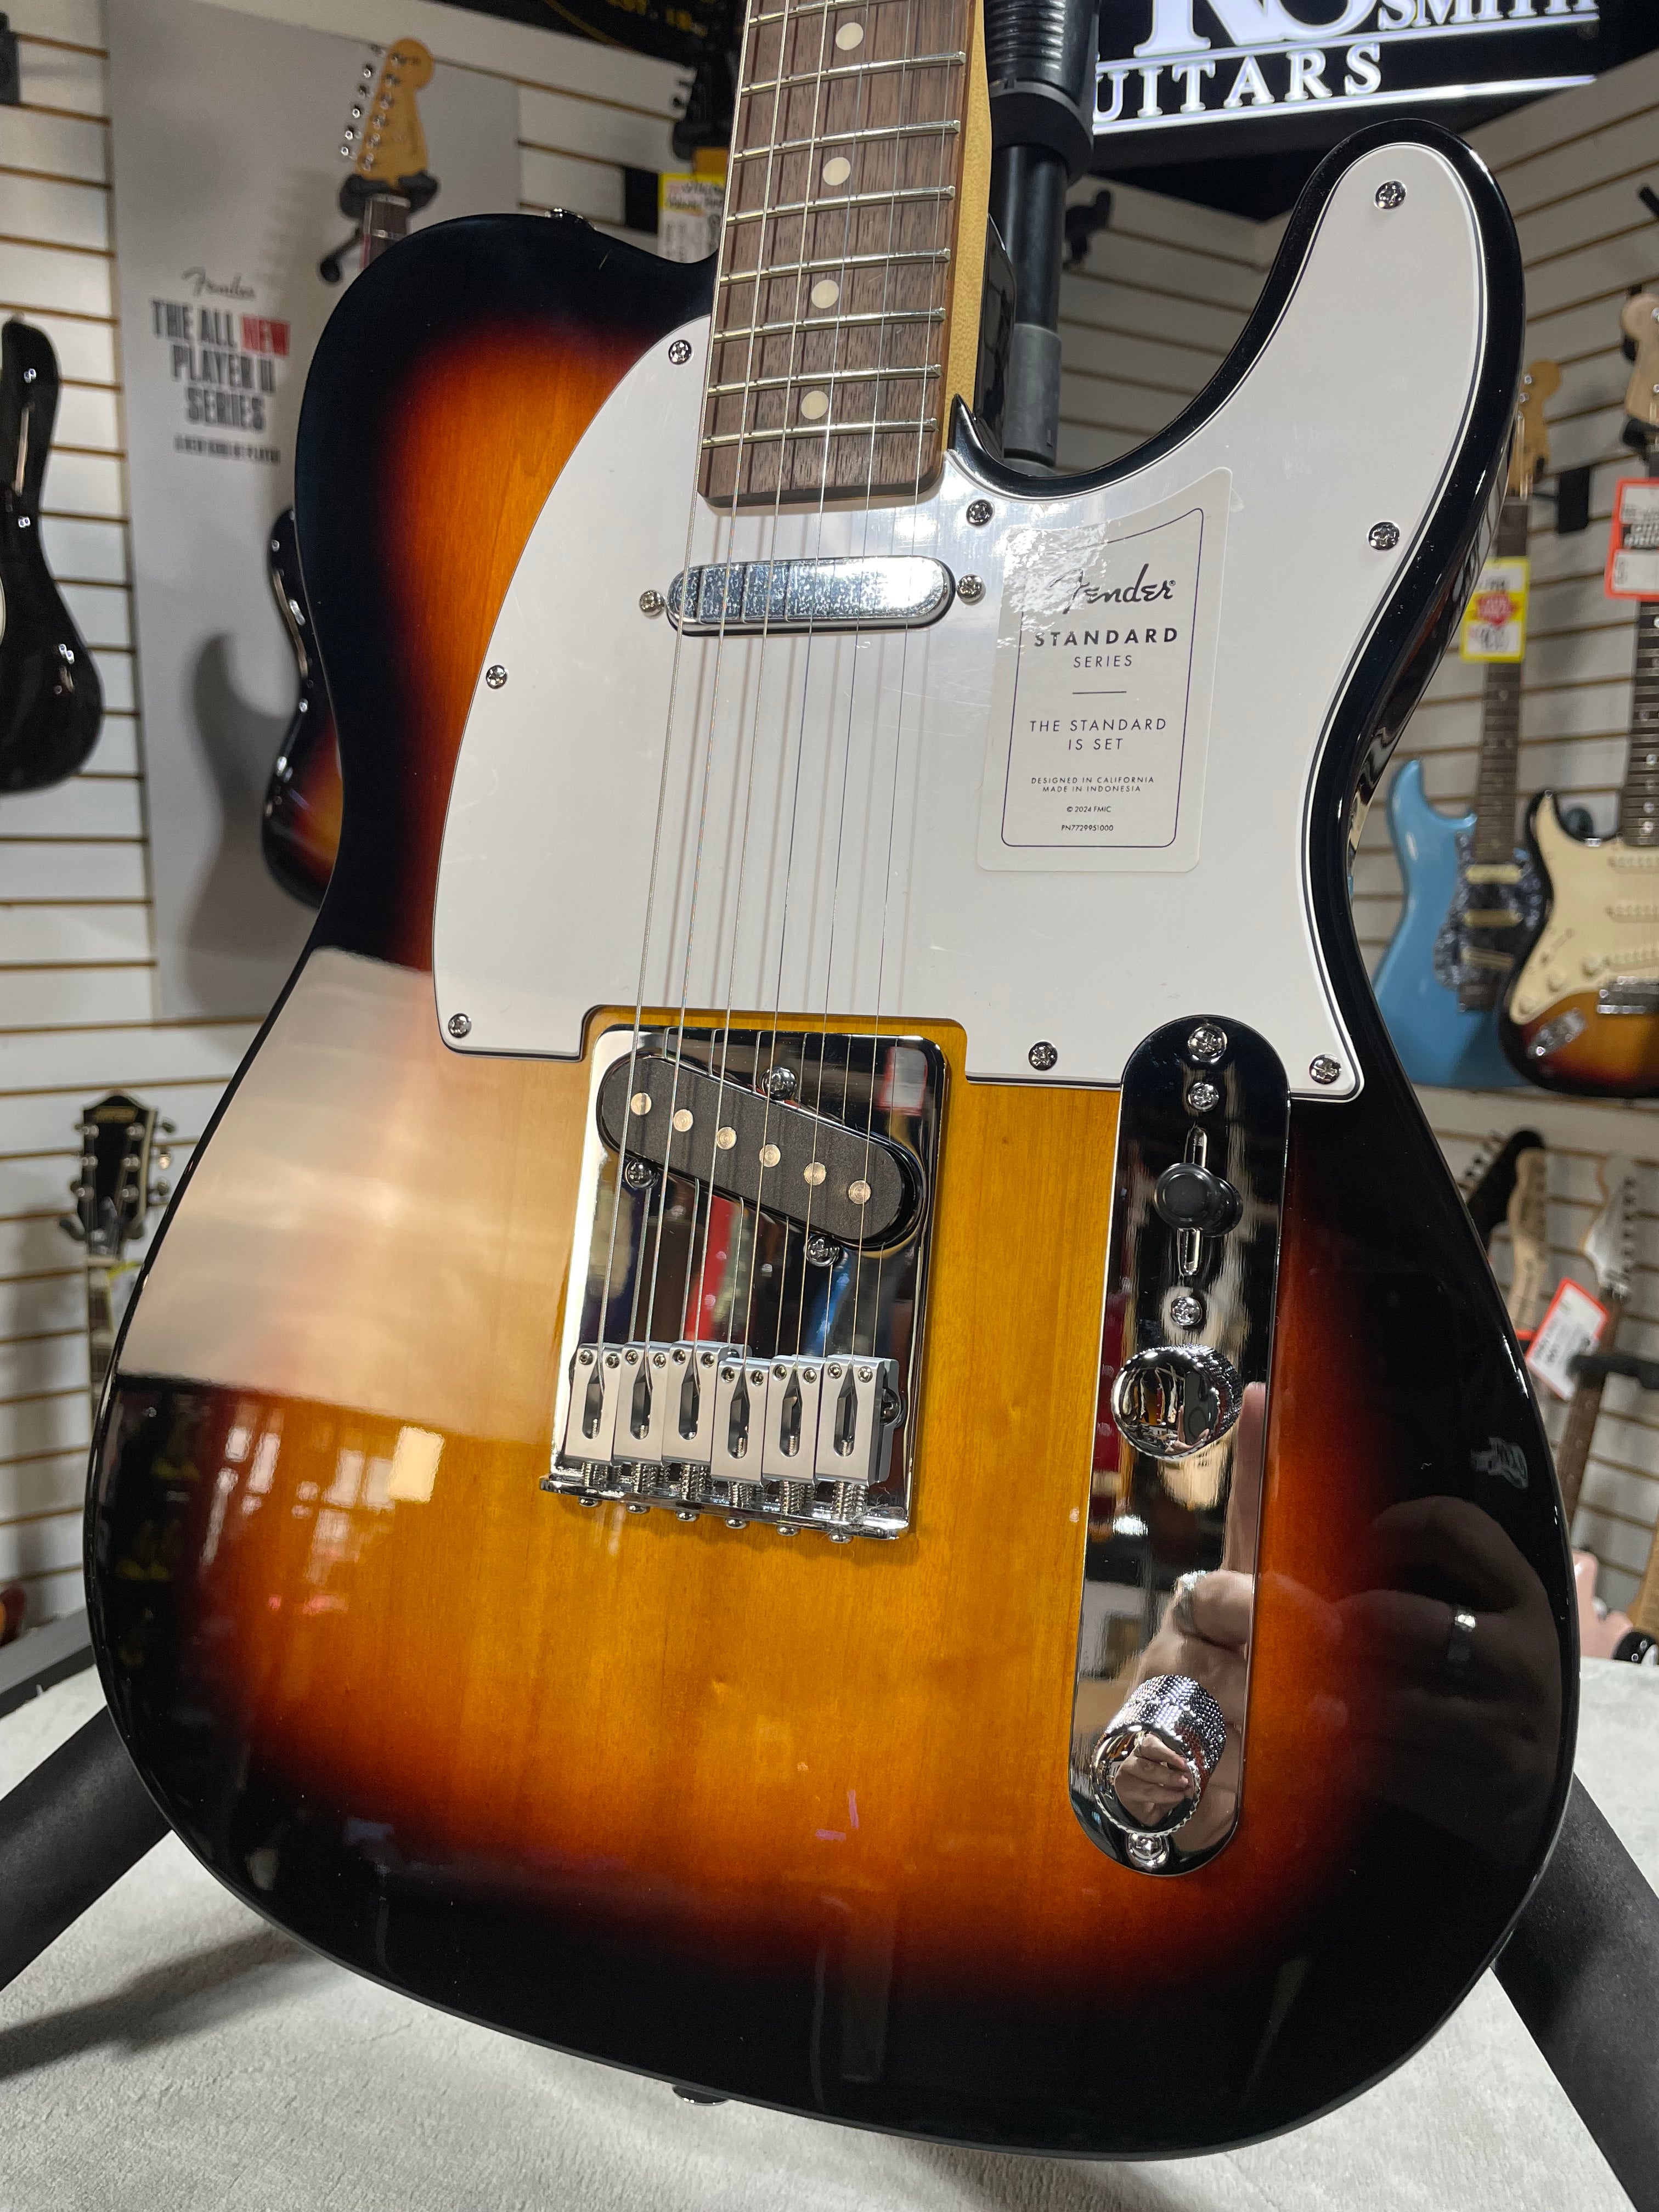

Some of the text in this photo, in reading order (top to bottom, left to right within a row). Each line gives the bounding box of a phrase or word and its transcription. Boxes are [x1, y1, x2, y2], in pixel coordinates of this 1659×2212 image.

[1092, 44, 1380, 122] UITARS
[151, 298, 192, 341] THE
[199, 307, 236, 348] ALL
[171, 344, 255, 388] PLAYER
[185, 385, 265, 432] SERIES
[1034, 627, 1178, 647] STANDARD
[1073, 654, 1132, 668] SERIES
[1029, 718, 1166, 732] THE STANDARD
[1068, 737, 1124, 751] IS SET
[1031, 776, 1078, 785] DESIGNED
